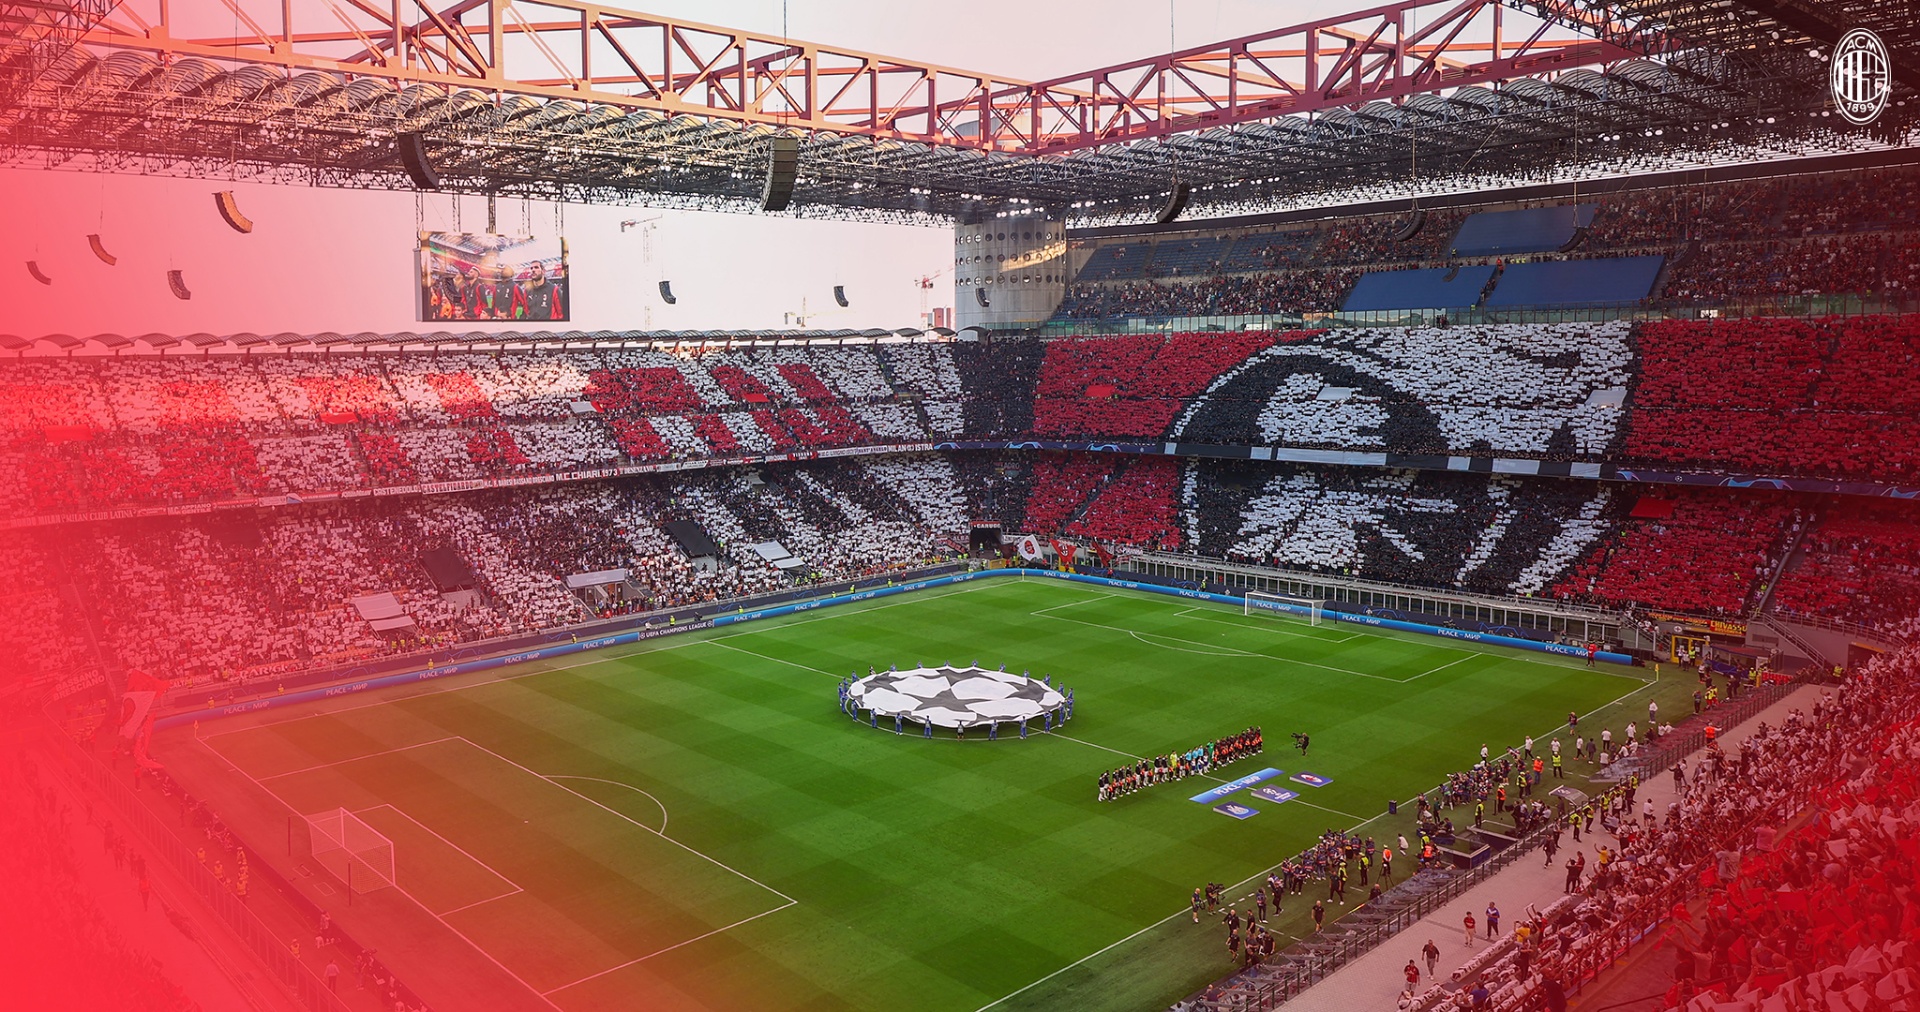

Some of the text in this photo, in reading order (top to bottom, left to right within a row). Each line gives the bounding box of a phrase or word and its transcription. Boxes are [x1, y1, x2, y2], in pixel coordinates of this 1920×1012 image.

[572, 470, 600, 480] CHIARI
[602, 469, 617, 477] 1973
[66, 513, 88, 522] MILAN
[90, 512, 108, 520] CLUB
[110, 510, 133, 519] LATINA
[1342, 614, 1360, 622] PEACE
[660, 626, 688, 635] CHAMPIONS
[689, 623, 707, 631] LEAGUE
[1437, 629, 1459, 638] PEACE
[1545, 645, 1568, 654] PEACE
[505, 656, 522, 664] PEACE
[420, 670, 437, 679] PEACE
[56, 669, 98, 692] BASSANO
[53, 675, 105, 701] BRESCIANO
[326, 687, 346, 696] PEACE
[224, 704, 246, 715] PEACE
[1213, 784, 1241, 796] PEACE
